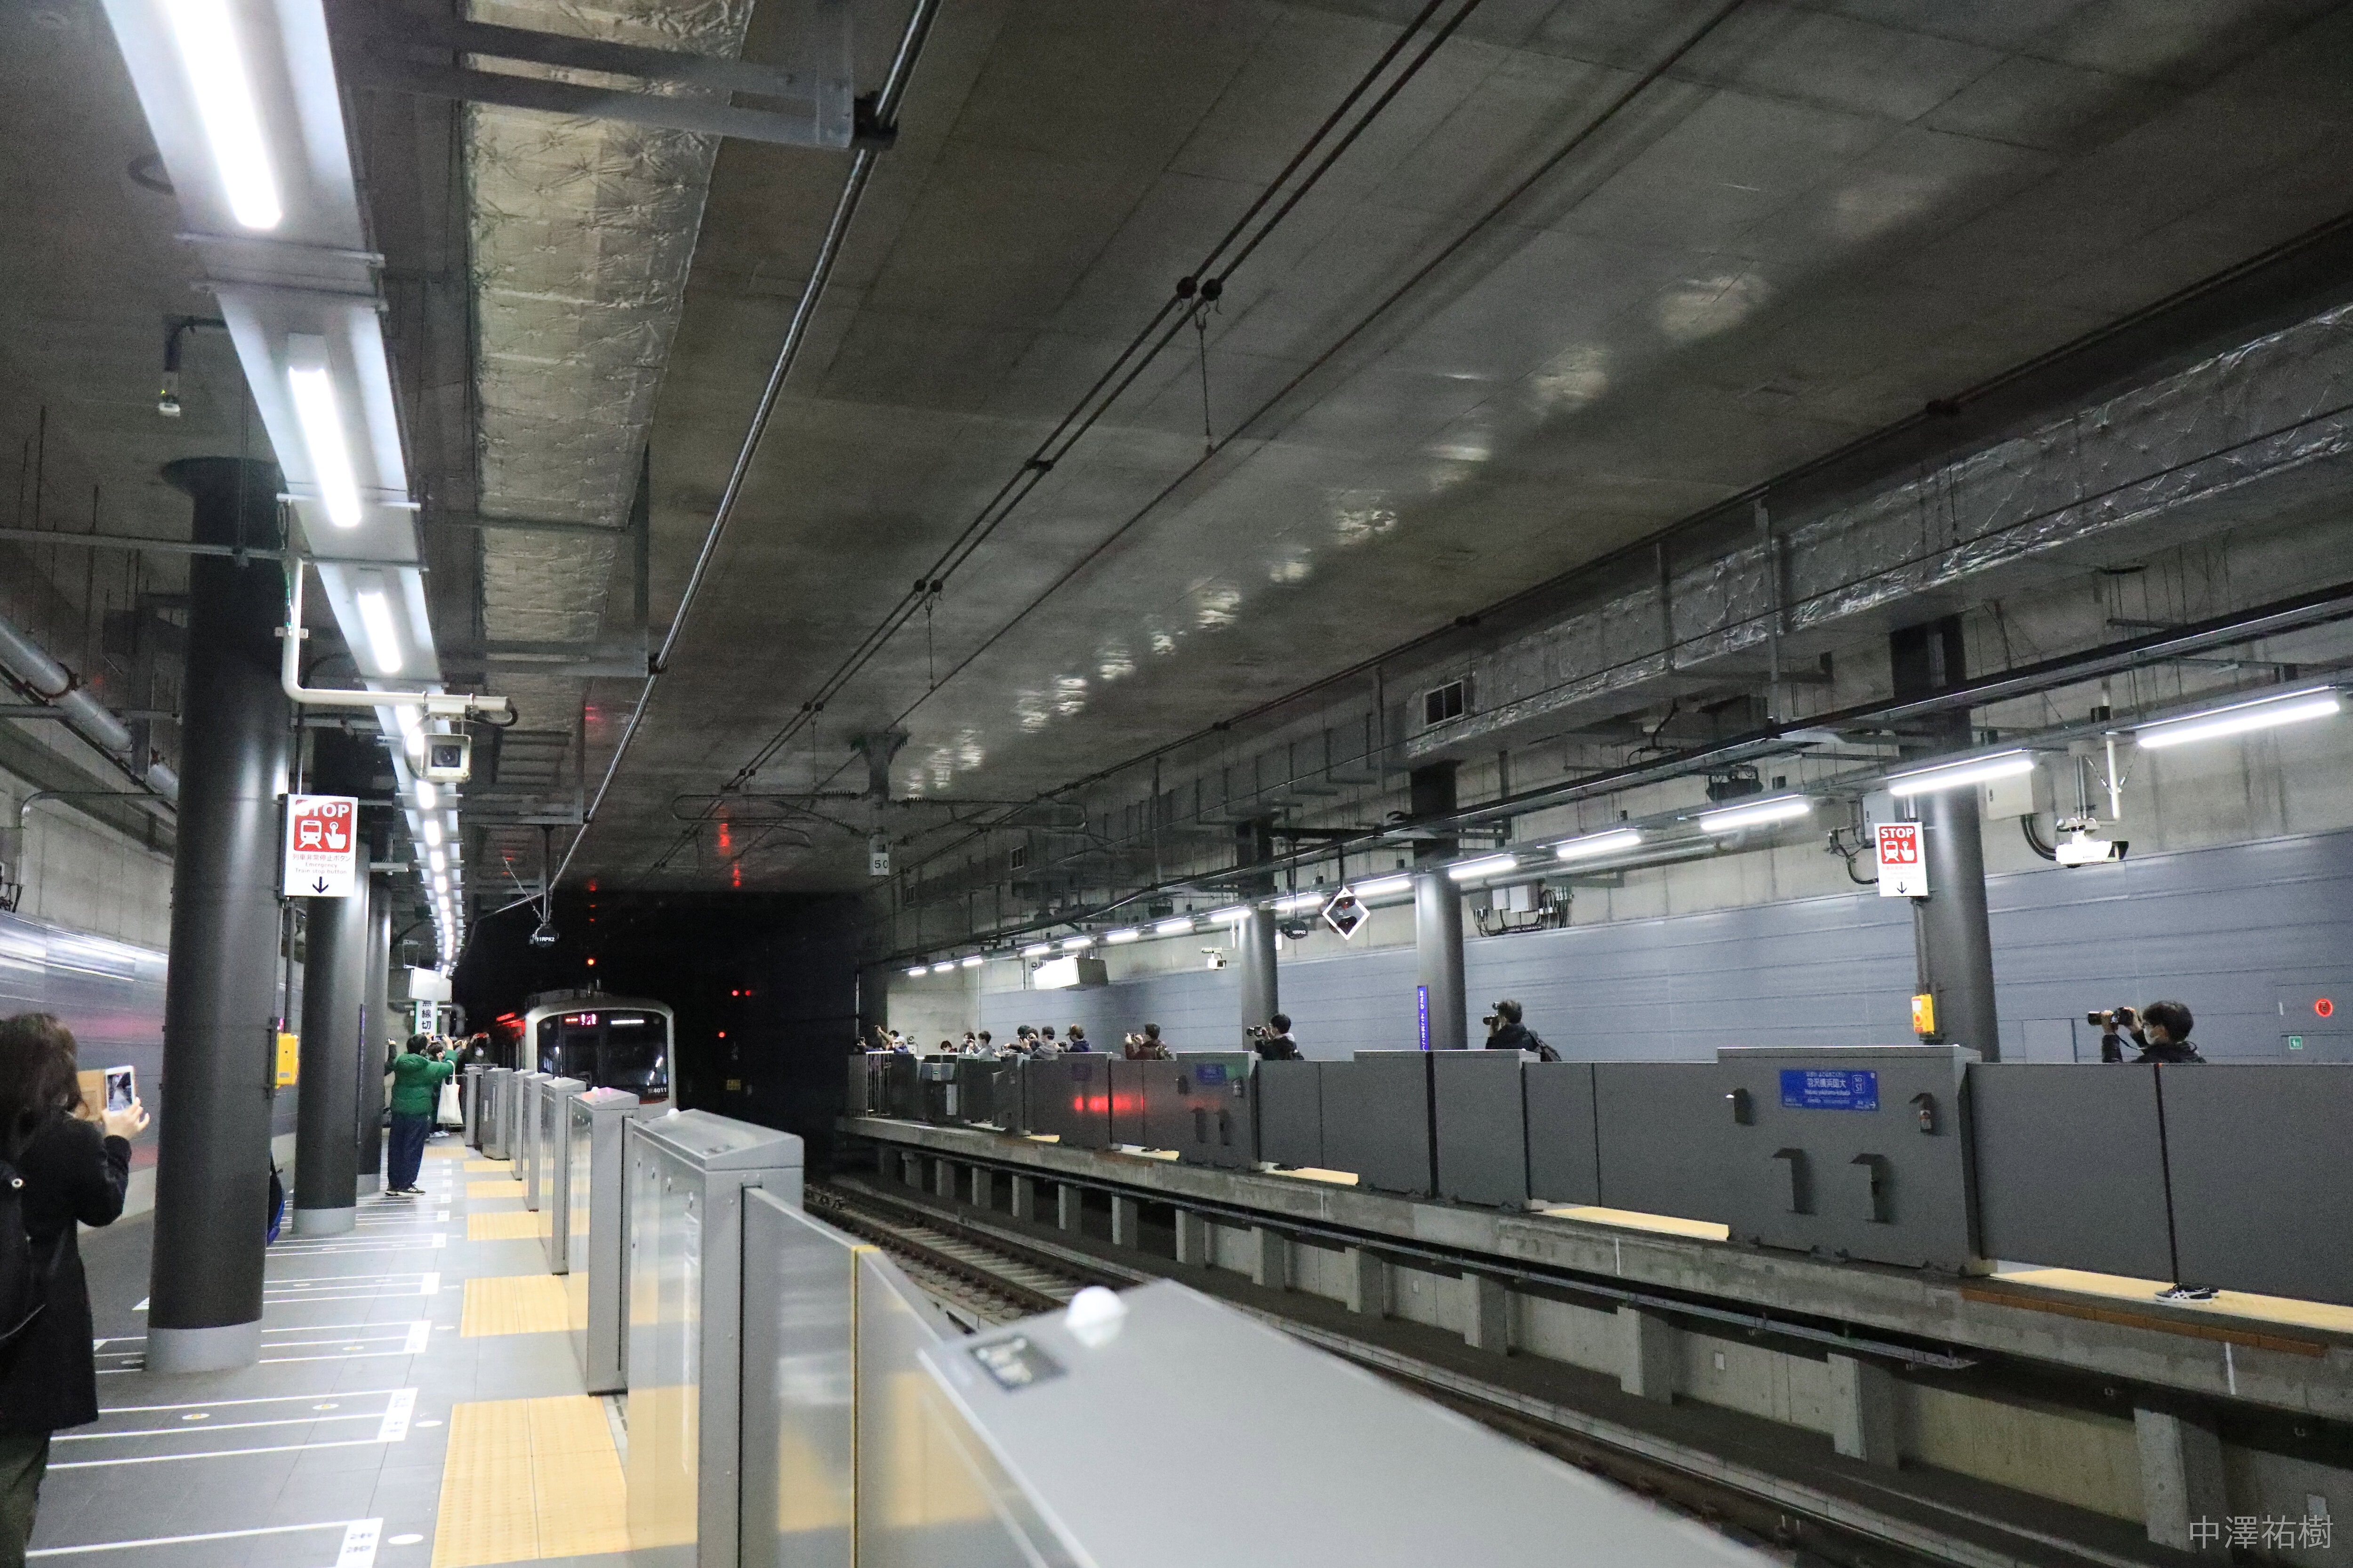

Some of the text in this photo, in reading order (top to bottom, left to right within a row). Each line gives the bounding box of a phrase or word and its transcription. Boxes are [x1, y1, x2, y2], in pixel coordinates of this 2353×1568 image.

[1880, 828, 1914, 839] STOP
[292, 853, 351, 862] 列車非常停止ボタン
[874, 860, 888, 869] 50
[421, 1000, 433, 1035] 無線切
[1855, 1084, 1863, 1092] 51
